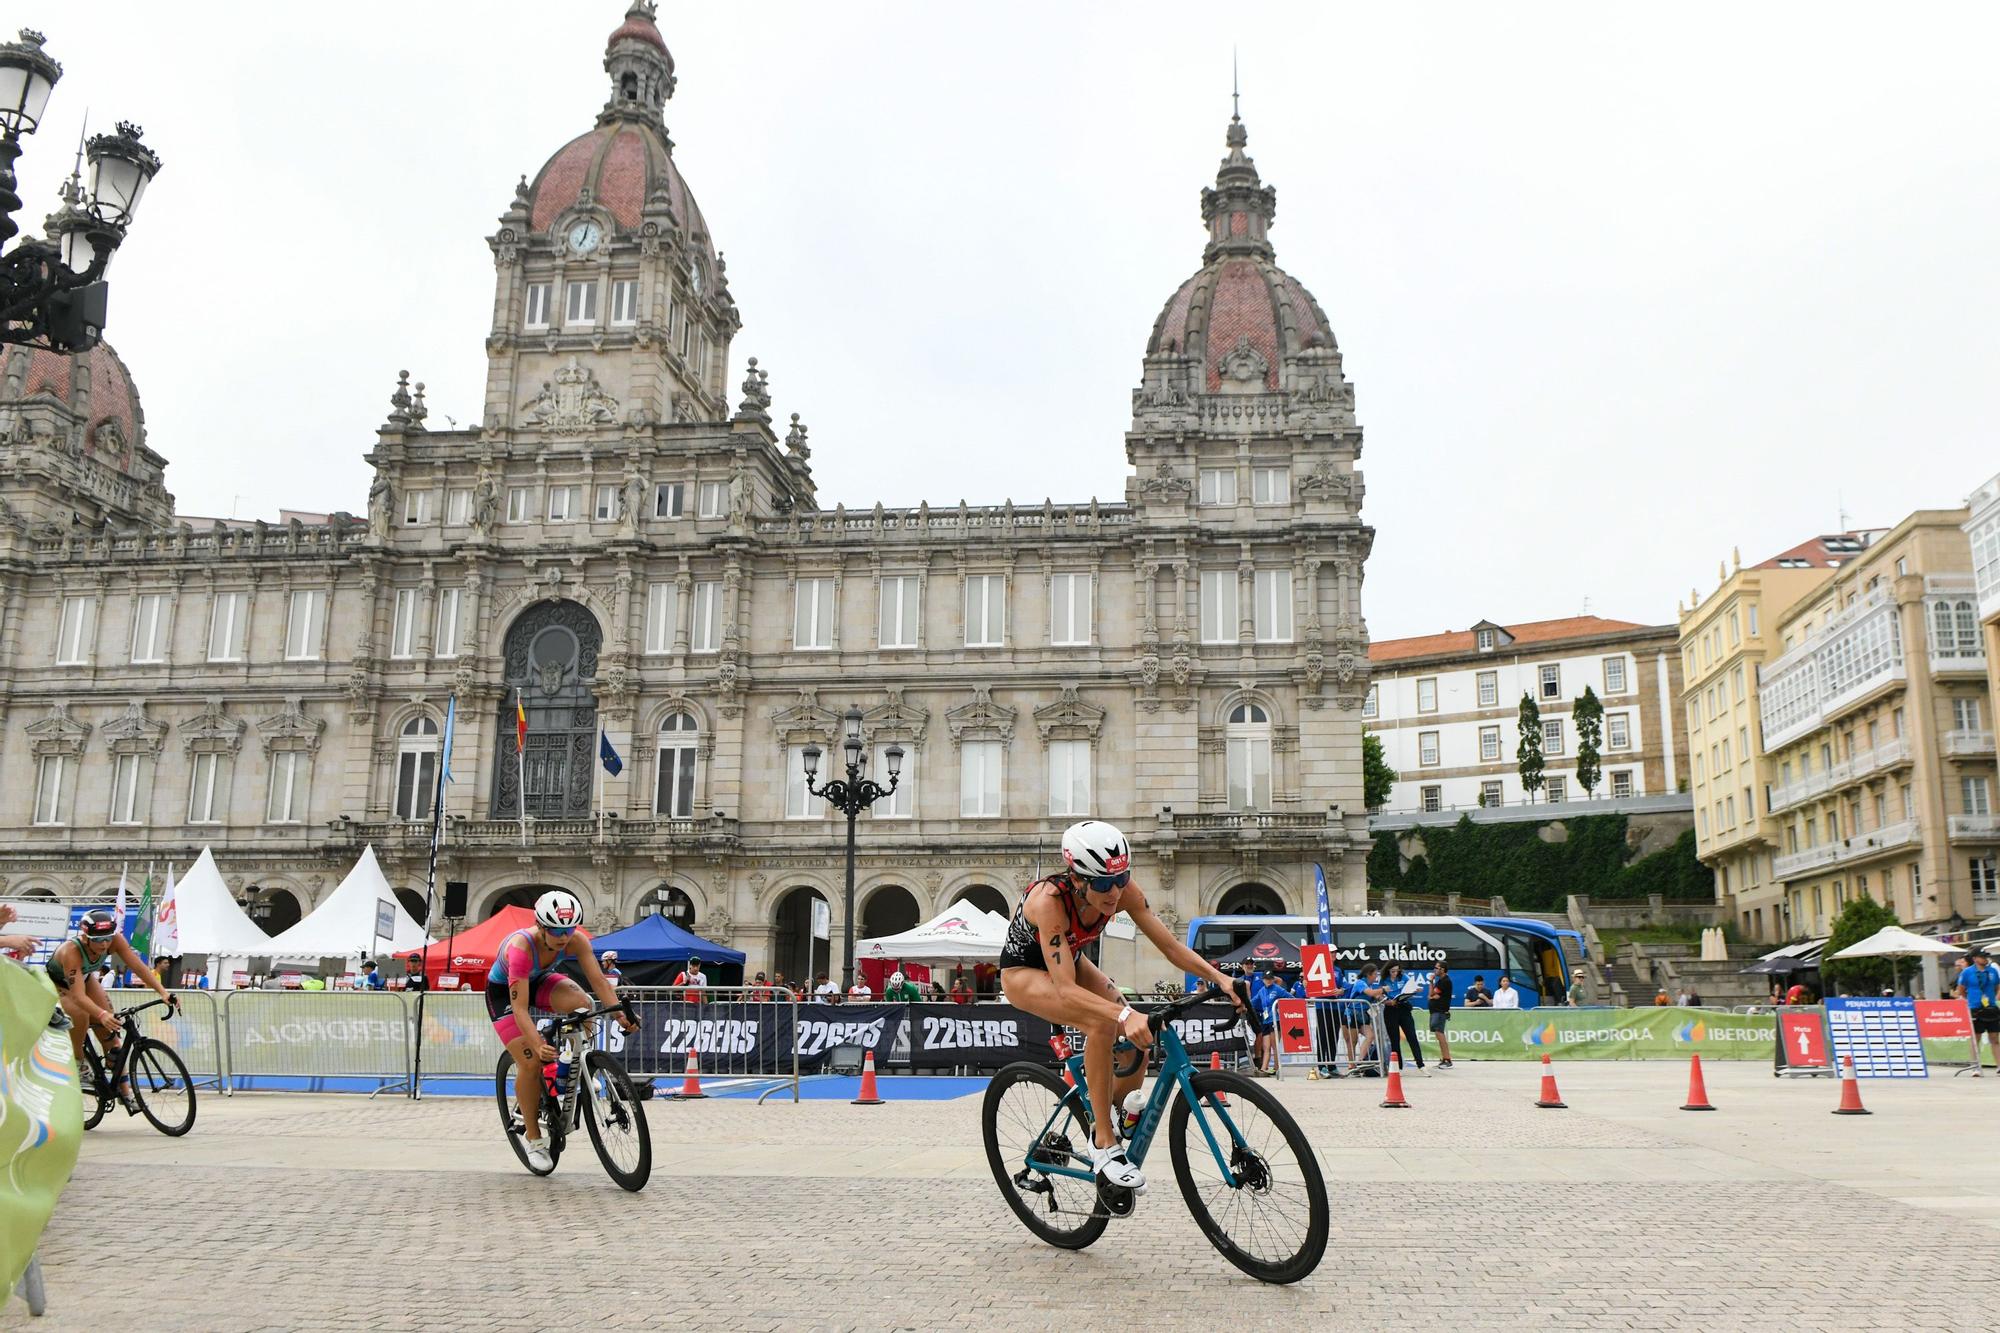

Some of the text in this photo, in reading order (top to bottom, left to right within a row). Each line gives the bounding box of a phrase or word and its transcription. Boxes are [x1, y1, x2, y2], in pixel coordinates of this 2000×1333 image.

[1379, 942, 1447, 961] atlántico
[1307, 953, 1331, 988] 4
[511, 990, 518, 1000] 9
[660, 1019, 758, 1054] 226ERS
[923, 1016, 1019, 1050] 226ERS
[1415, 1030, 1504, 1043] BEDROLA
[1559, 1027, 1654, 1043] IBERDROLA
[1708, 1027, 1777, 1042] IBERDR
[523, 1047, 533, 1060] 9
